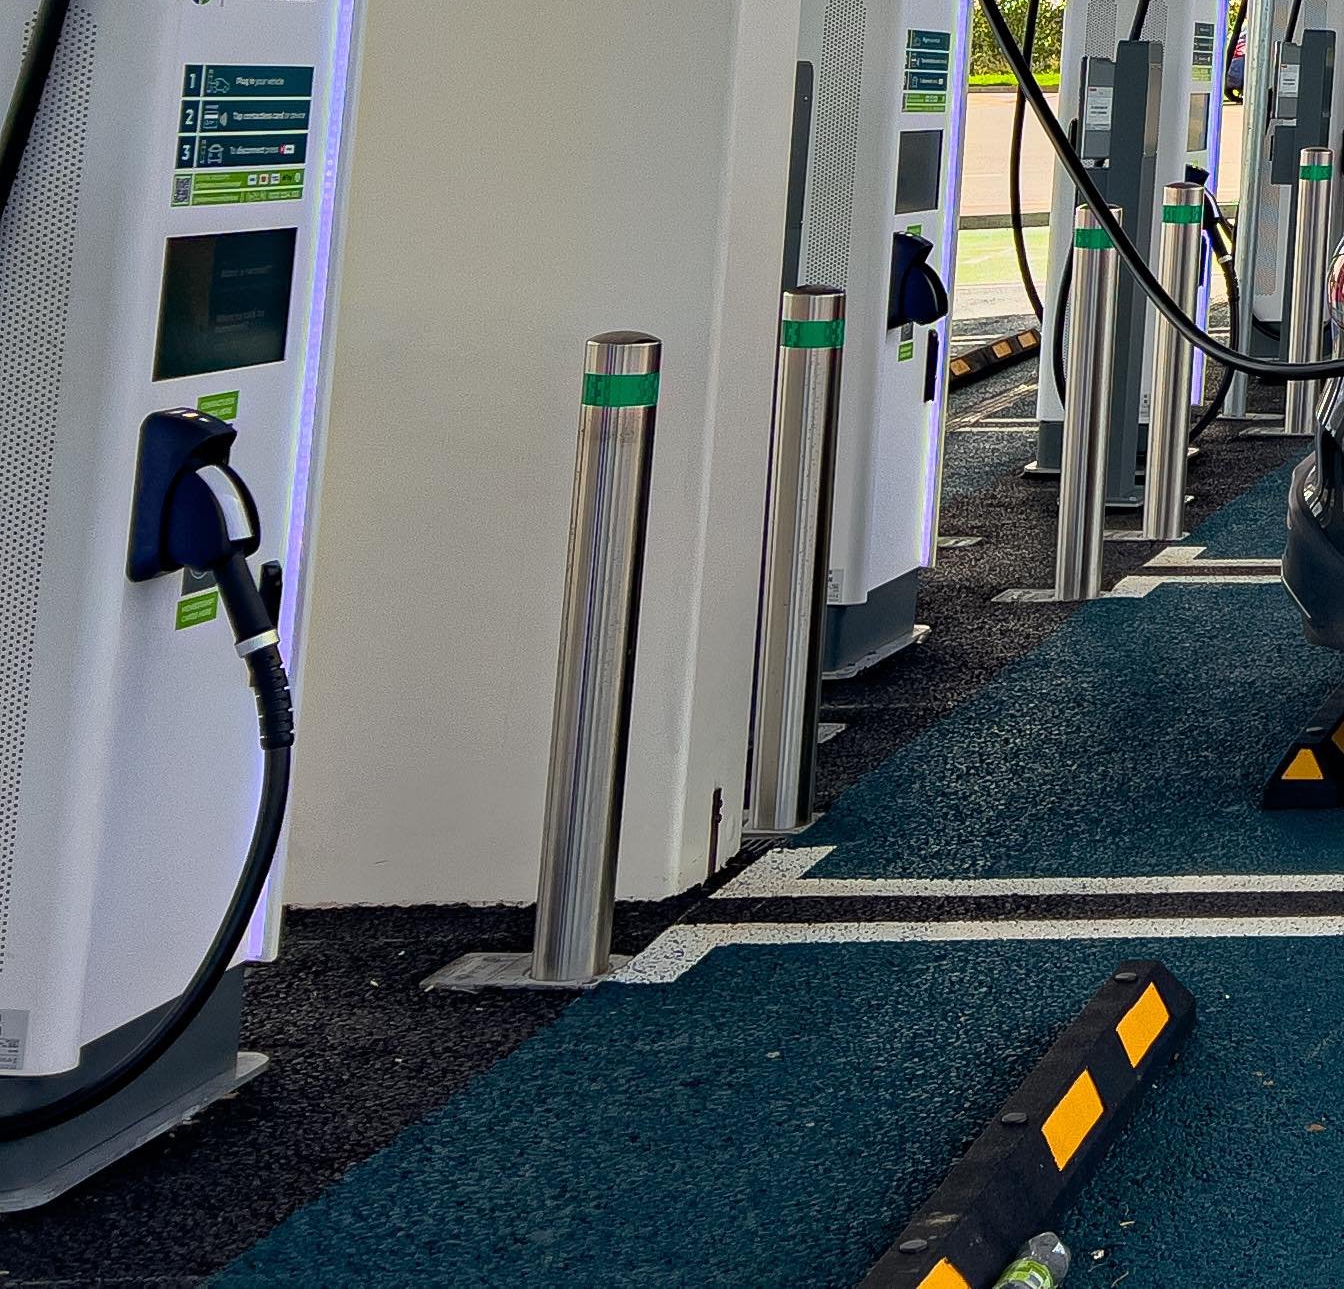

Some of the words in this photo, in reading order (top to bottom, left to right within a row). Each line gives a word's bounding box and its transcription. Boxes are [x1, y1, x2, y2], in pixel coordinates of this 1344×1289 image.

[190, 74, 196, 89] 1
[185, 109, 194, 126] 2
[181, 144, 191, 161] 3
